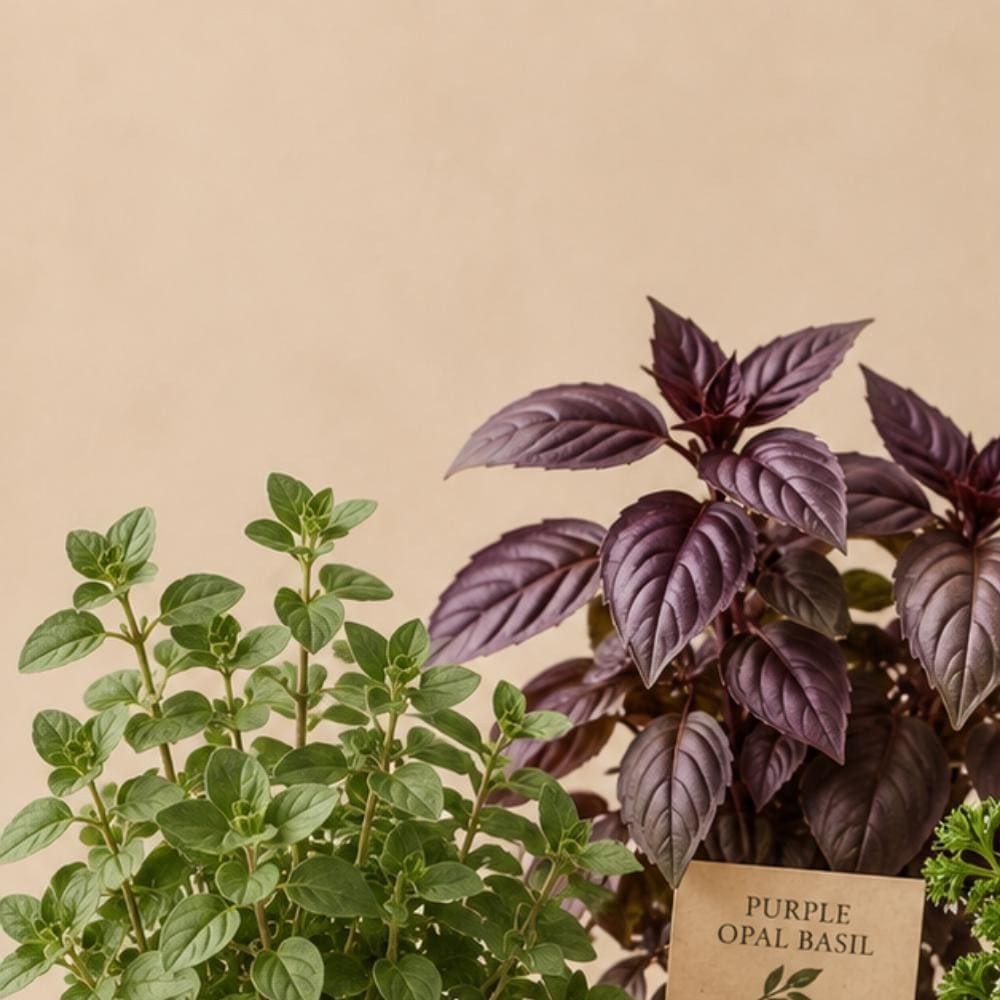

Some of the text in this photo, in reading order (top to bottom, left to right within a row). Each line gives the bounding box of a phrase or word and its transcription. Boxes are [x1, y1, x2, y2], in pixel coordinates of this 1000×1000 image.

[746, 895, 851, 925] PURPLE
[717, 923, 874, 957] OPAL BASIL
